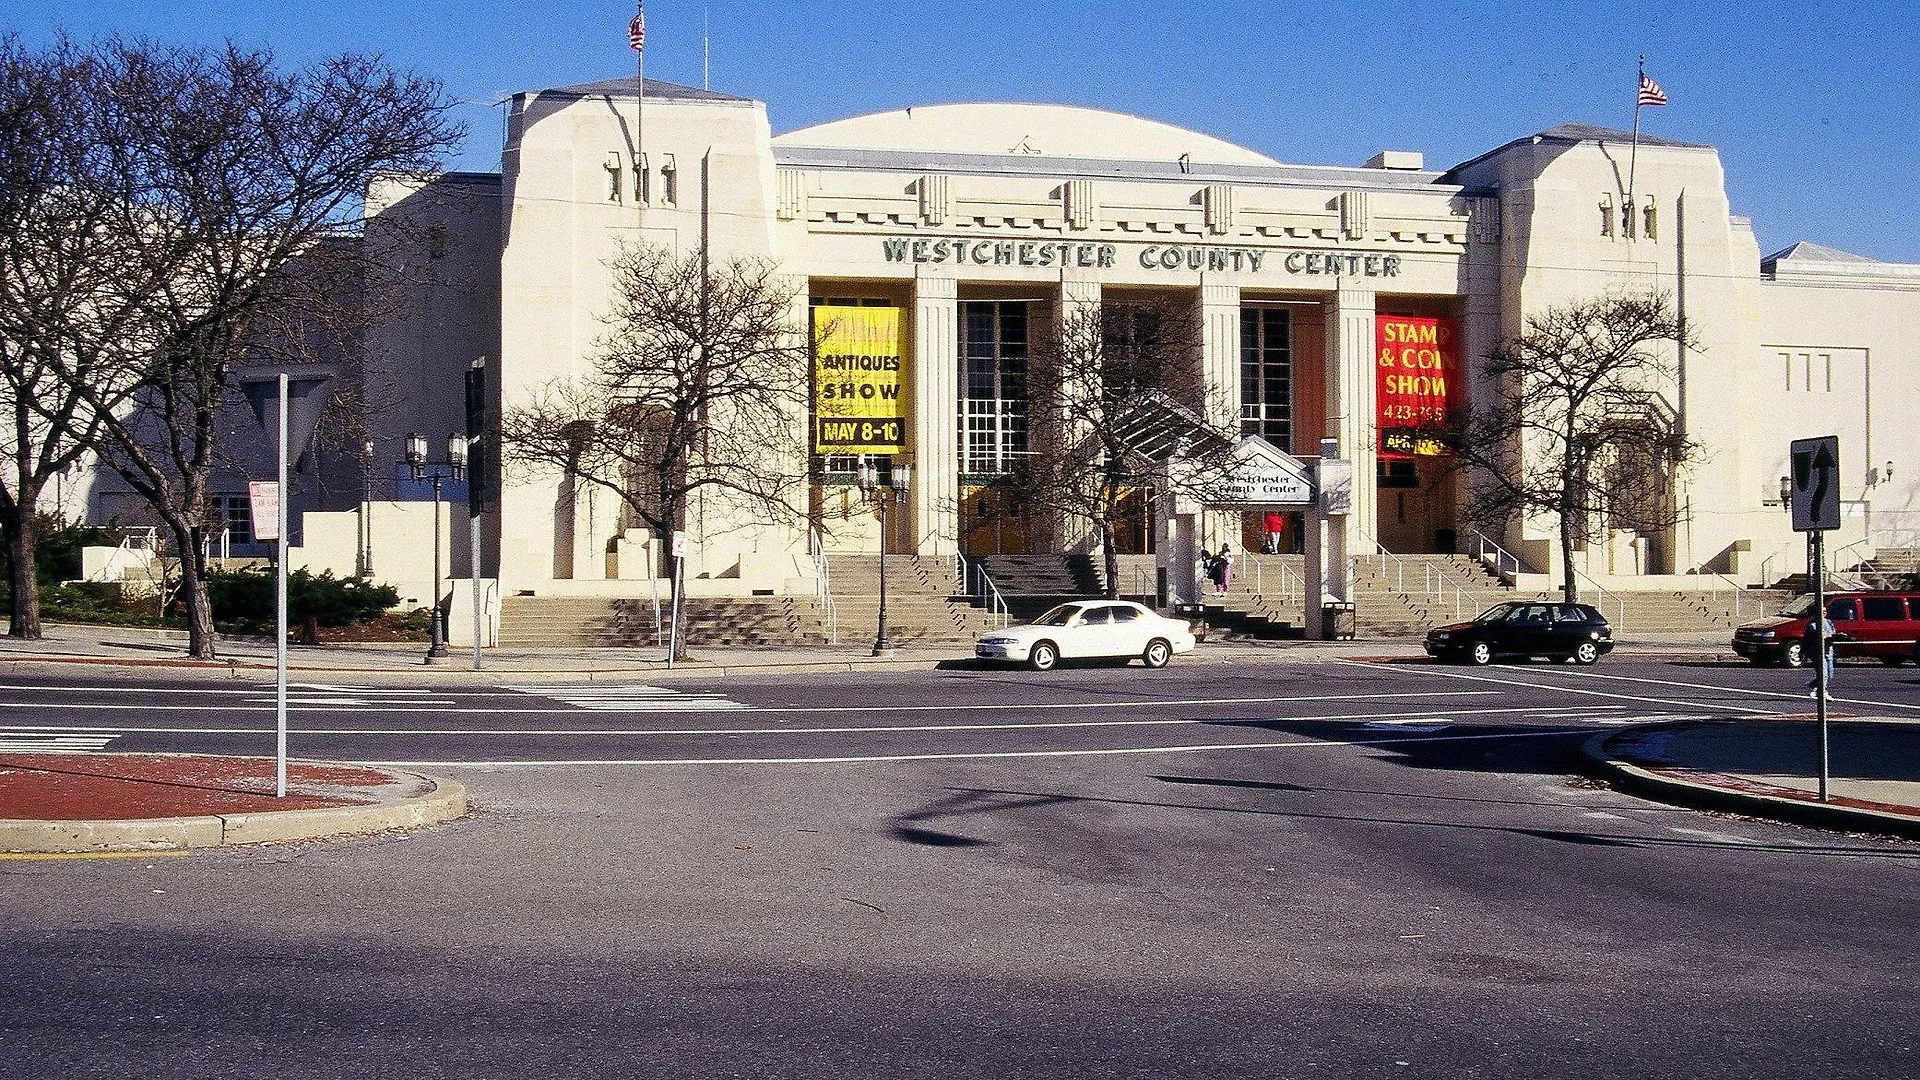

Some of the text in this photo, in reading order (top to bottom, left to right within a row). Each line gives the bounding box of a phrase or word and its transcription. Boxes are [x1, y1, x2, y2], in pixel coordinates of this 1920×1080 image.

[882, 237, 1401, 277] WESTCHESTER COUNTY CENTER
[823, 355, 900, 371] ANTIQUES
[1379, 348, 1395, 367] &
[823, 383, 901, 399] SHOW
[1385, 375, 1448, 397] SHOW
[824, 422, 898, 441] MAY 8-10
[1226, 475, 1290, 483] estchester
[1263, 485, 1298, 493] Center
